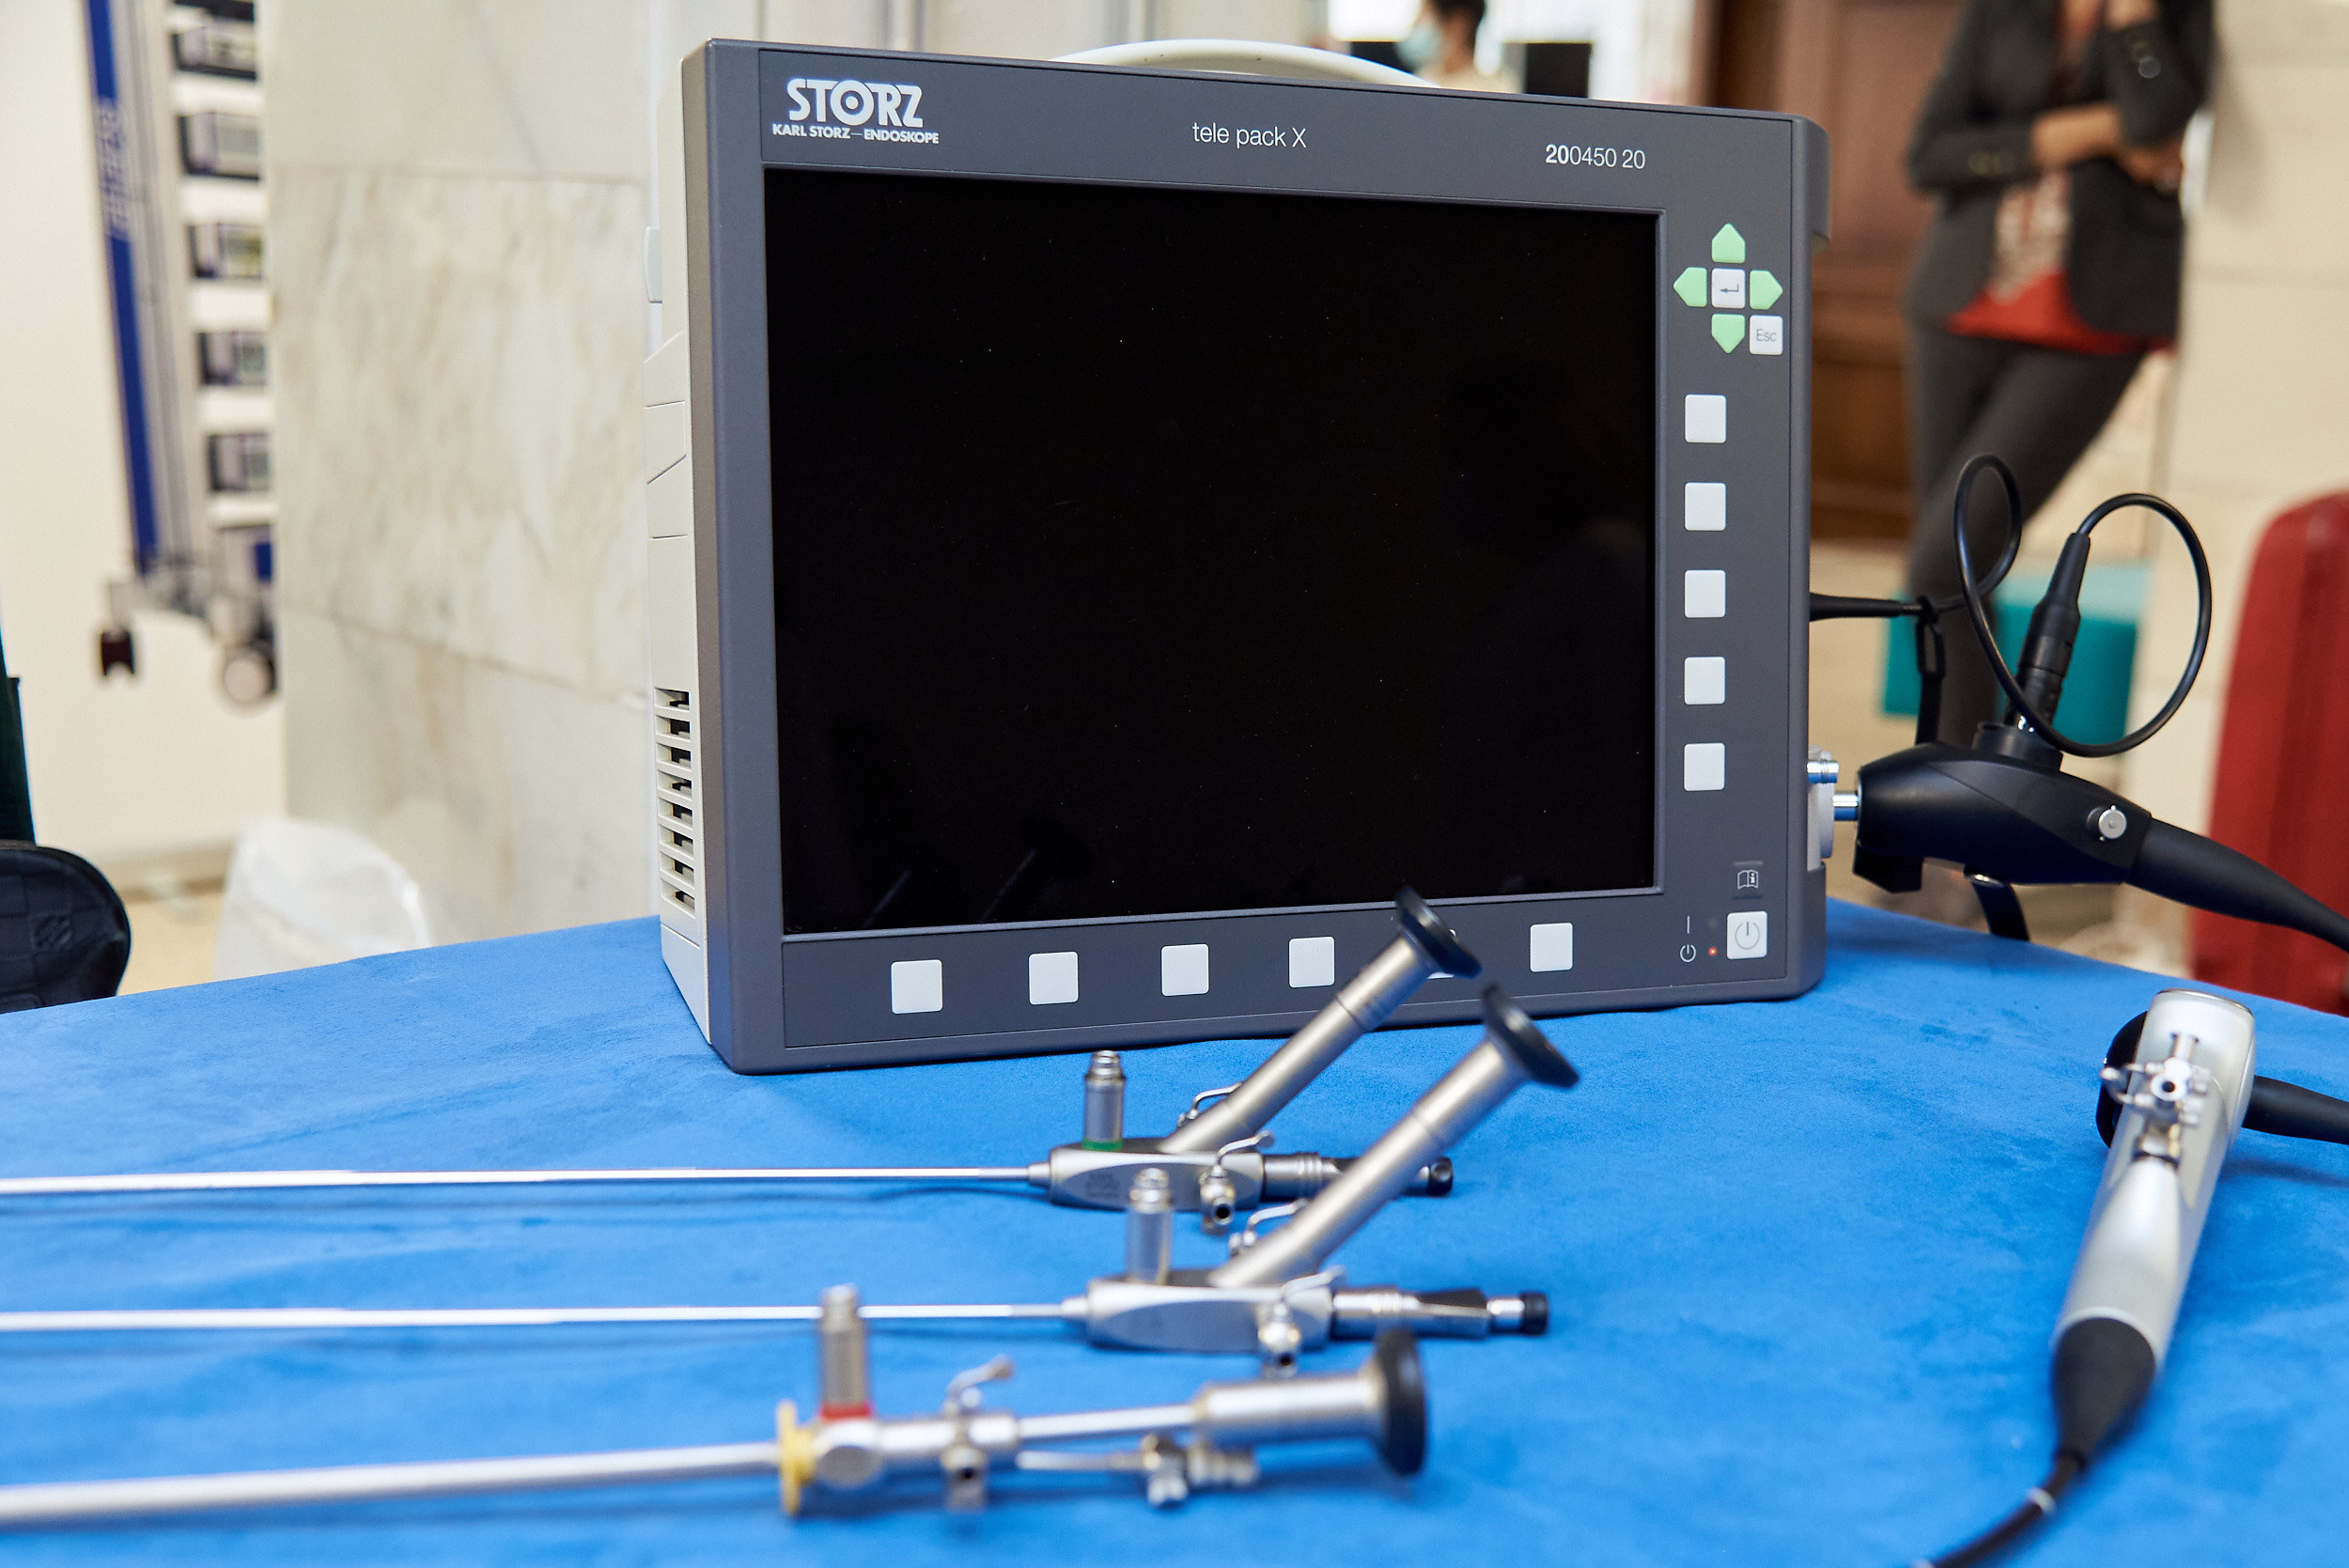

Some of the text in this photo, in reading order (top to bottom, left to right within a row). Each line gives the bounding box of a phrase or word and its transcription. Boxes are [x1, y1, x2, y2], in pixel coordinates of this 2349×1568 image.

[786, 78, 924, 128] STORZ
[772, 123, 807, 137] KARL
[1191, 121, 1307, 149] tele pack X
[1545, 144, 1646, 170] 200450 20
[1756, 328, 1777, 342] Esc
